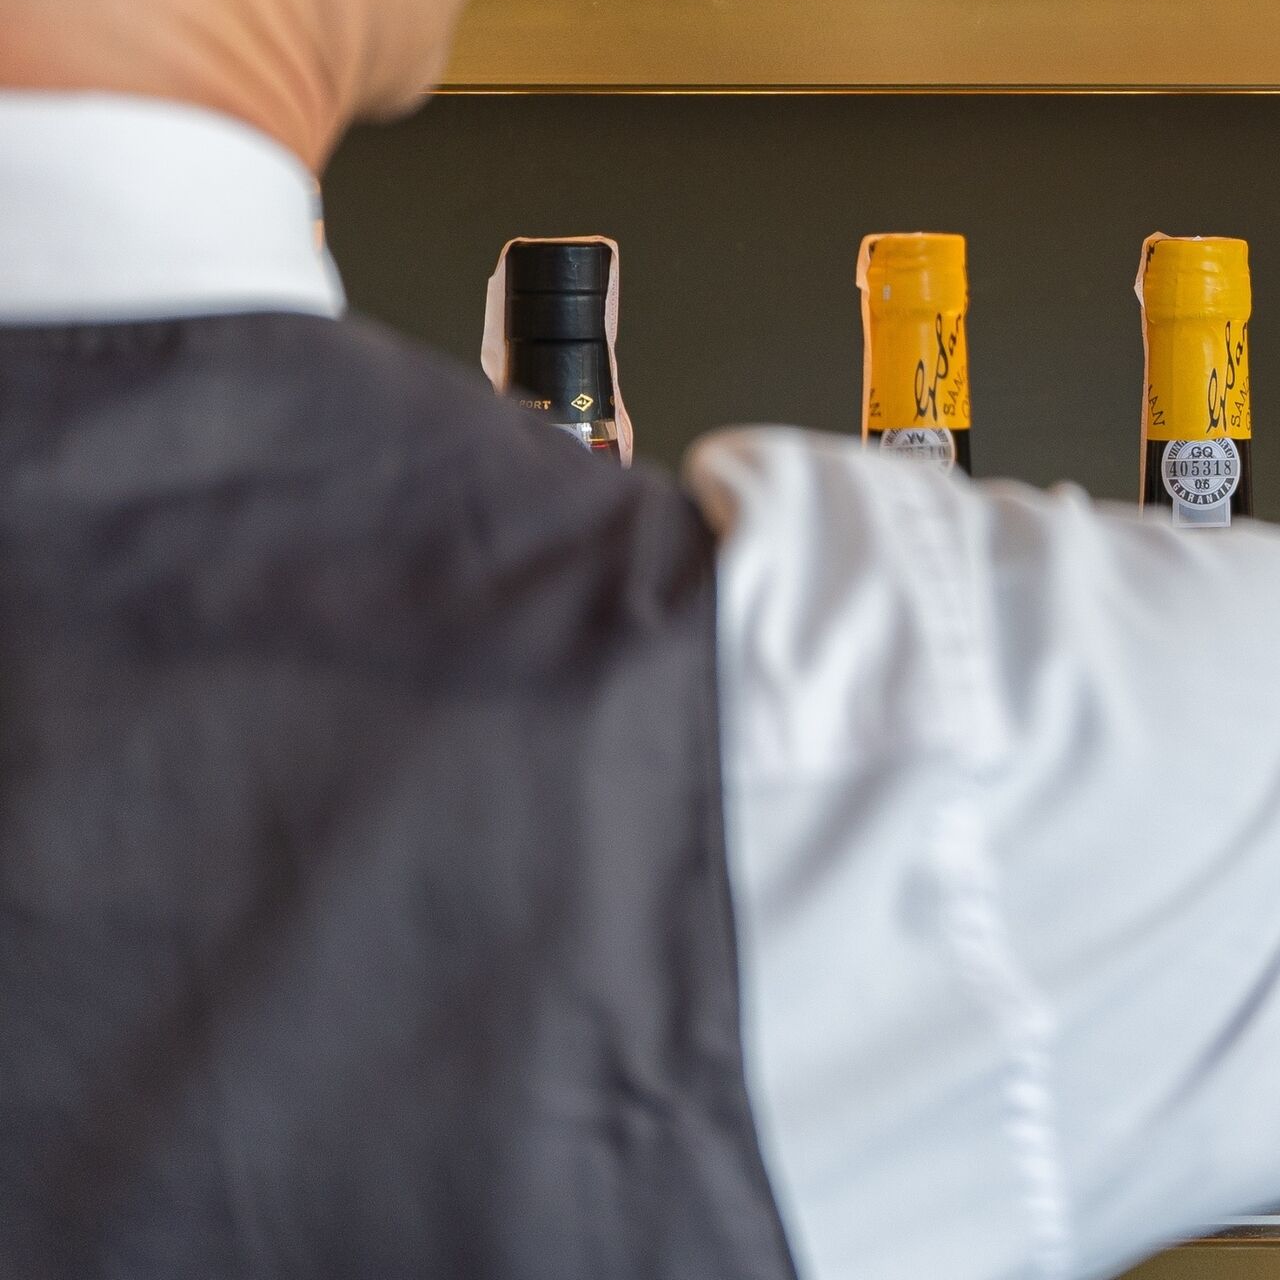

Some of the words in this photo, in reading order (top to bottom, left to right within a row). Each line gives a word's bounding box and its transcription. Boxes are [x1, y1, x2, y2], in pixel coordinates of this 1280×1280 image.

[1191, 446, 1213, 458] GQ
[1169, 459, 1232, 477] 405318
[1171, 481, 1233, 505] GARANTIA
